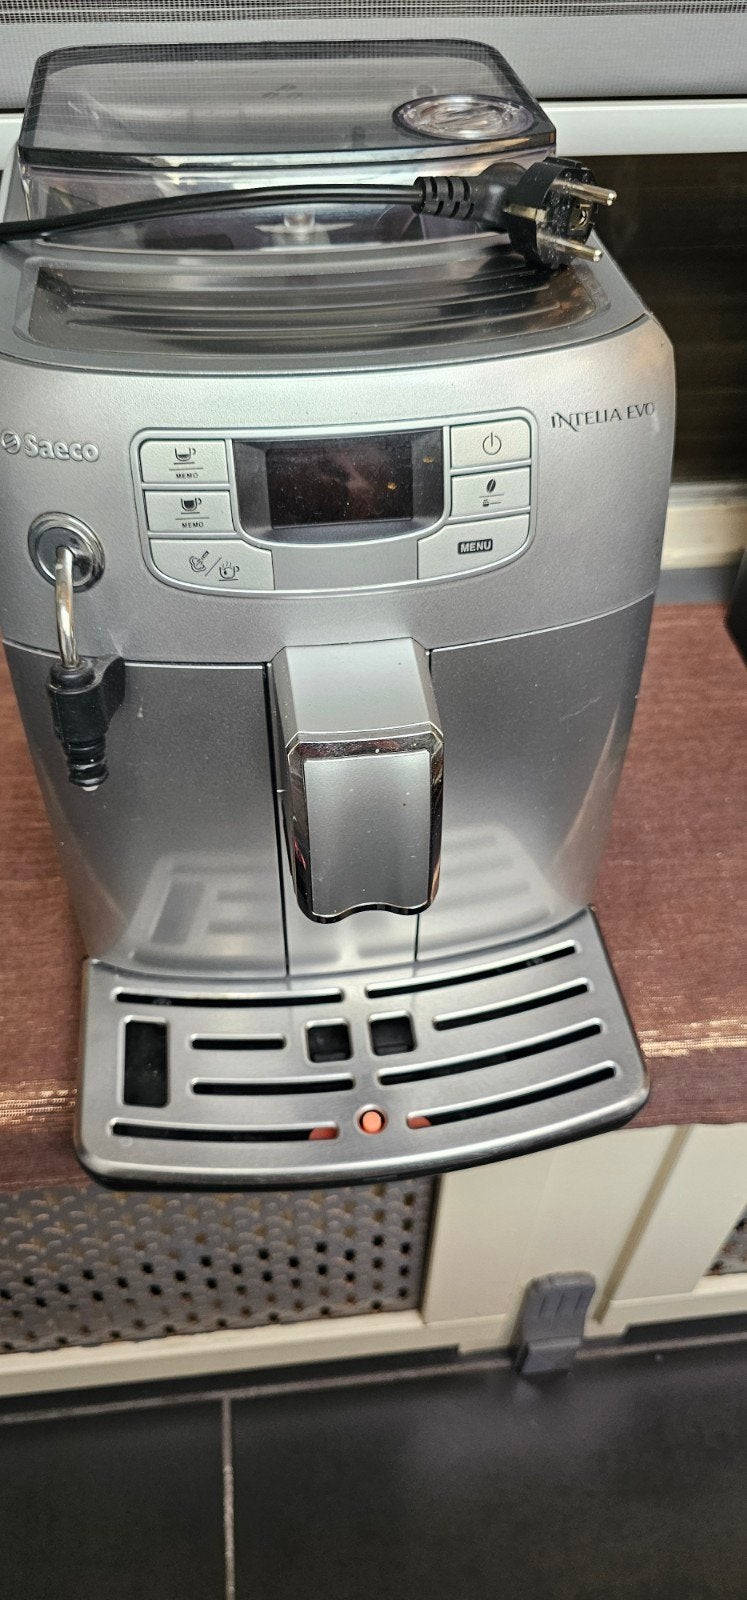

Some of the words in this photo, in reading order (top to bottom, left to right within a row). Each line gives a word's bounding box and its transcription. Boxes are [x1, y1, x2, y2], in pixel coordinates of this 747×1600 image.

[551, 408, 622, 432] INTELIA
[627, 402, 655, 419] EVO
[23, 432, 99, 462] Saeco
[460, 540, 491, 553] MENU
